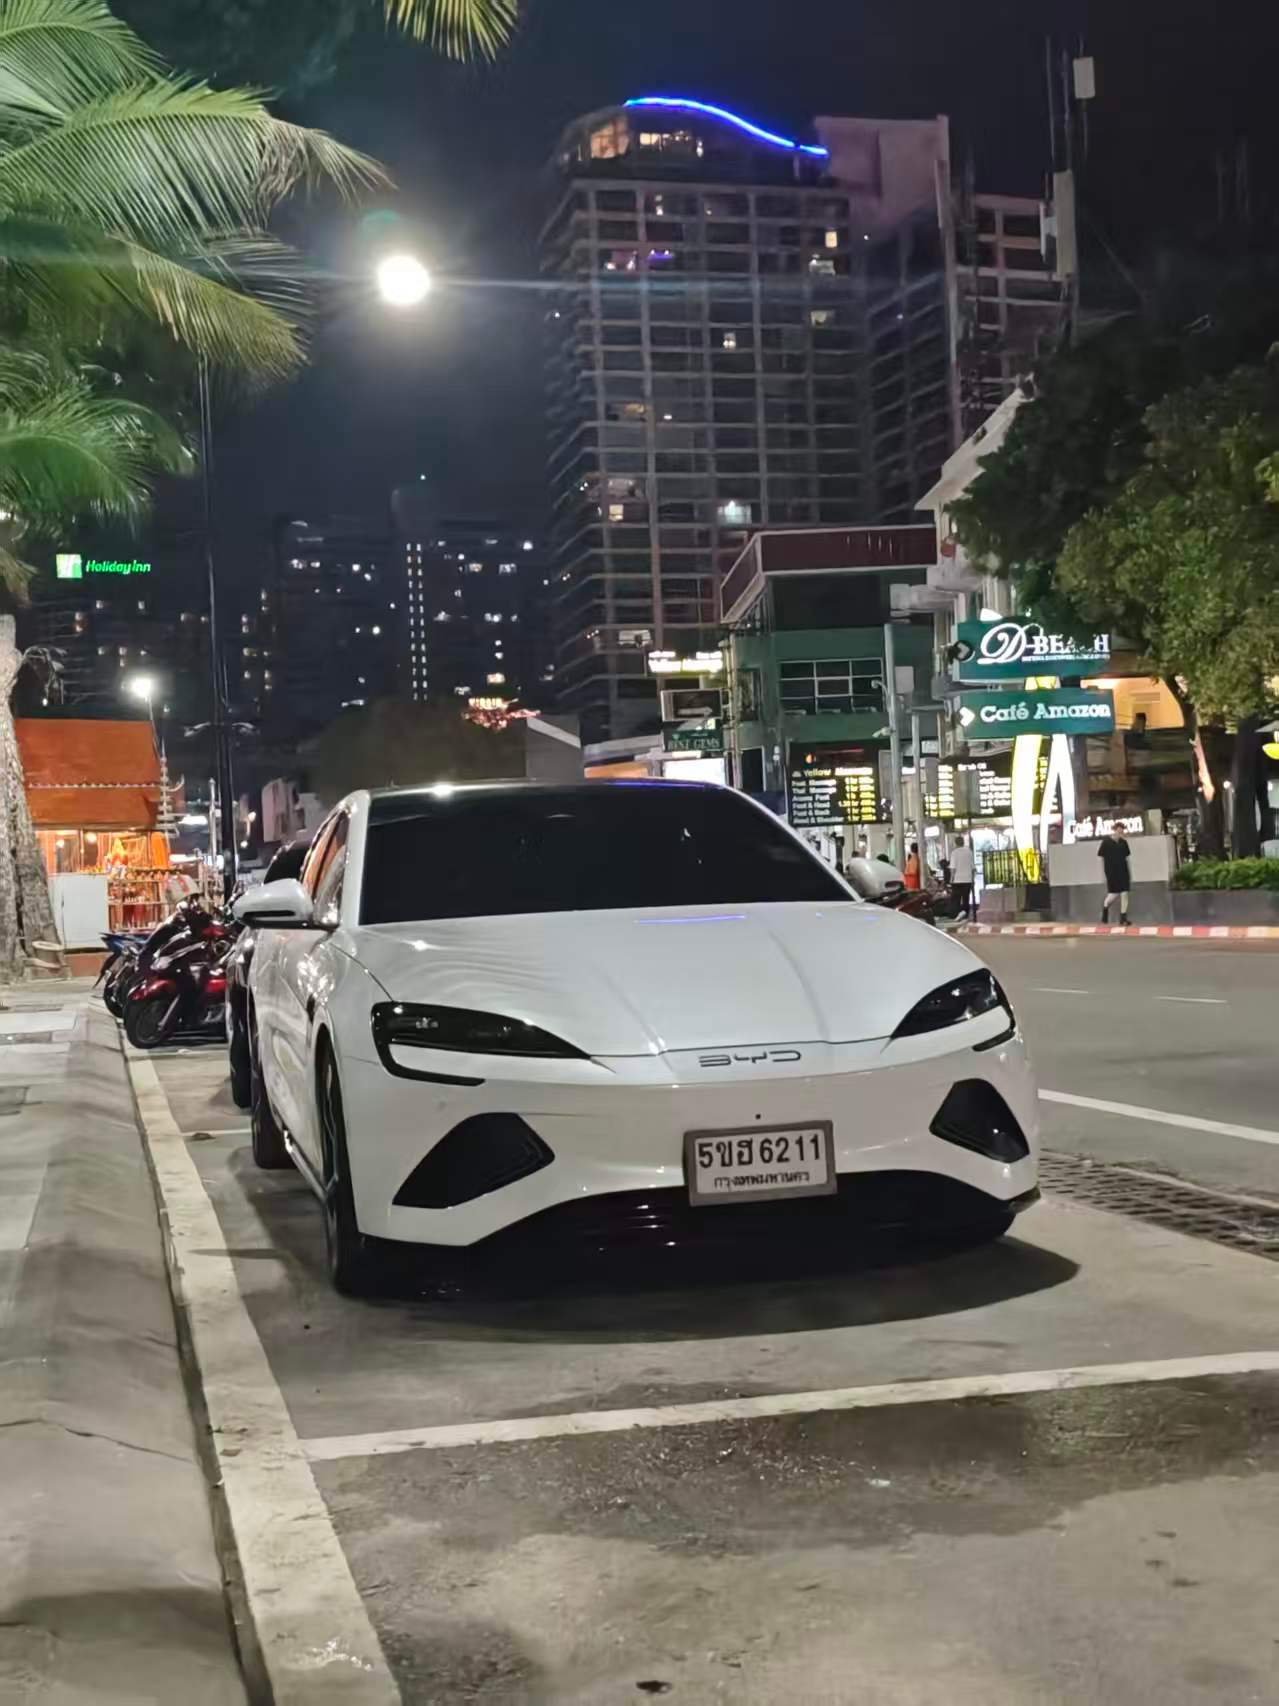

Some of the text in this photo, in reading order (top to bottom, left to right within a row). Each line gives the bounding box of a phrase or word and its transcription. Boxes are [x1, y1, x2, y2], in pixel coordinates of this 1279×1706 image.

[86, 560, 131, 575] Holiday
[977, 623, 1110, 664] D-BEAH
[980, 702, 1111, 722] Café Amazon
[693, 737, 720, 750] GEMS
[698, 1050, 802, 1067] BYD
[759, 1134, 821, 1164] 6211
